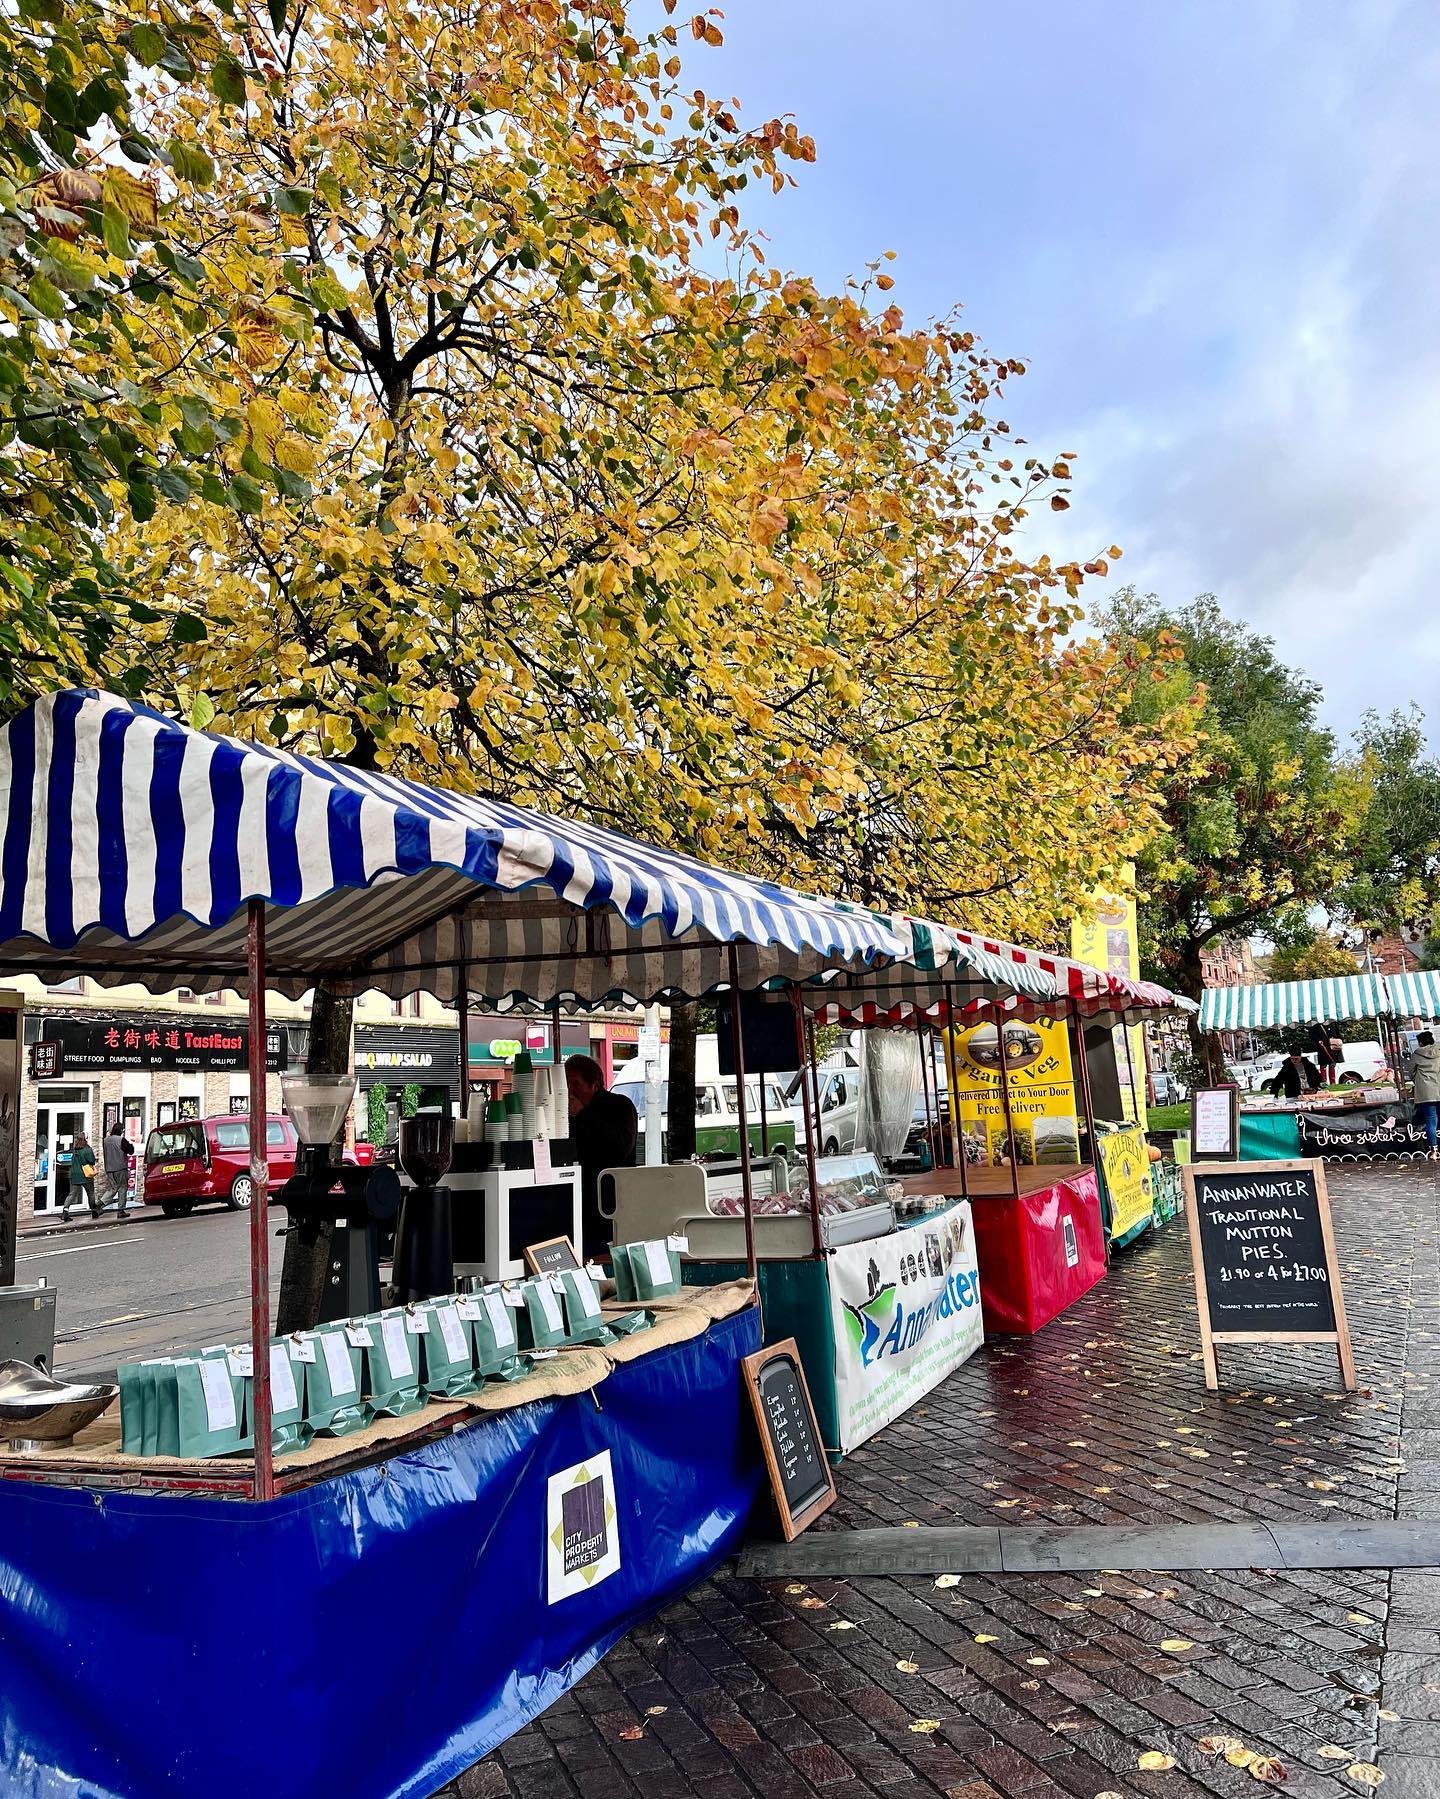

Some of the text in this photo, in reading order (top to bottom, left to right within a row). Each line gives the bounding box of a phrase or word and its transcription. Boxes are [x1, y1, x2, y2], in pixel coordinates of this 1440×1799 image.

[104, 1027, 180, 1050] 老街味道
[184, 1032, 243, 1049] TastEast
[88, 1055, 105, 1063] FOOD
[1023, 1055, 1060, 1080] Veg
[959, 1090, 990, 1101] elivered
[1017, 1089, 1026, 1099] to
[1027, 1086, 1047, 1098] Your
[1049, 1087, 1070, 1097] Door
[976, 1101, 1047, 1115] Free elivery
[1315, 1128, 1354, 1146] three
[1357, 1126, 1406, 1145] sisters
[1202, 1180, 1309, 1203] ANNANWATER
[1207, 1206, 1305, 1225] TRADITIONAL
[1226, 1226, 1294, 1241] MUTTON
[543, 1251, 563, 1264] FOLLOW
[1241, 1243, 1288, 1261] PIES.
[1220, 1262, 1327, 1281] £1.90 or 4 for £7.00
[565, 1530, 583, 1548] CITY
[565, 1532, 604, 1560] PROPERTY
[565, 1548, 599, 1572] MARKETS
